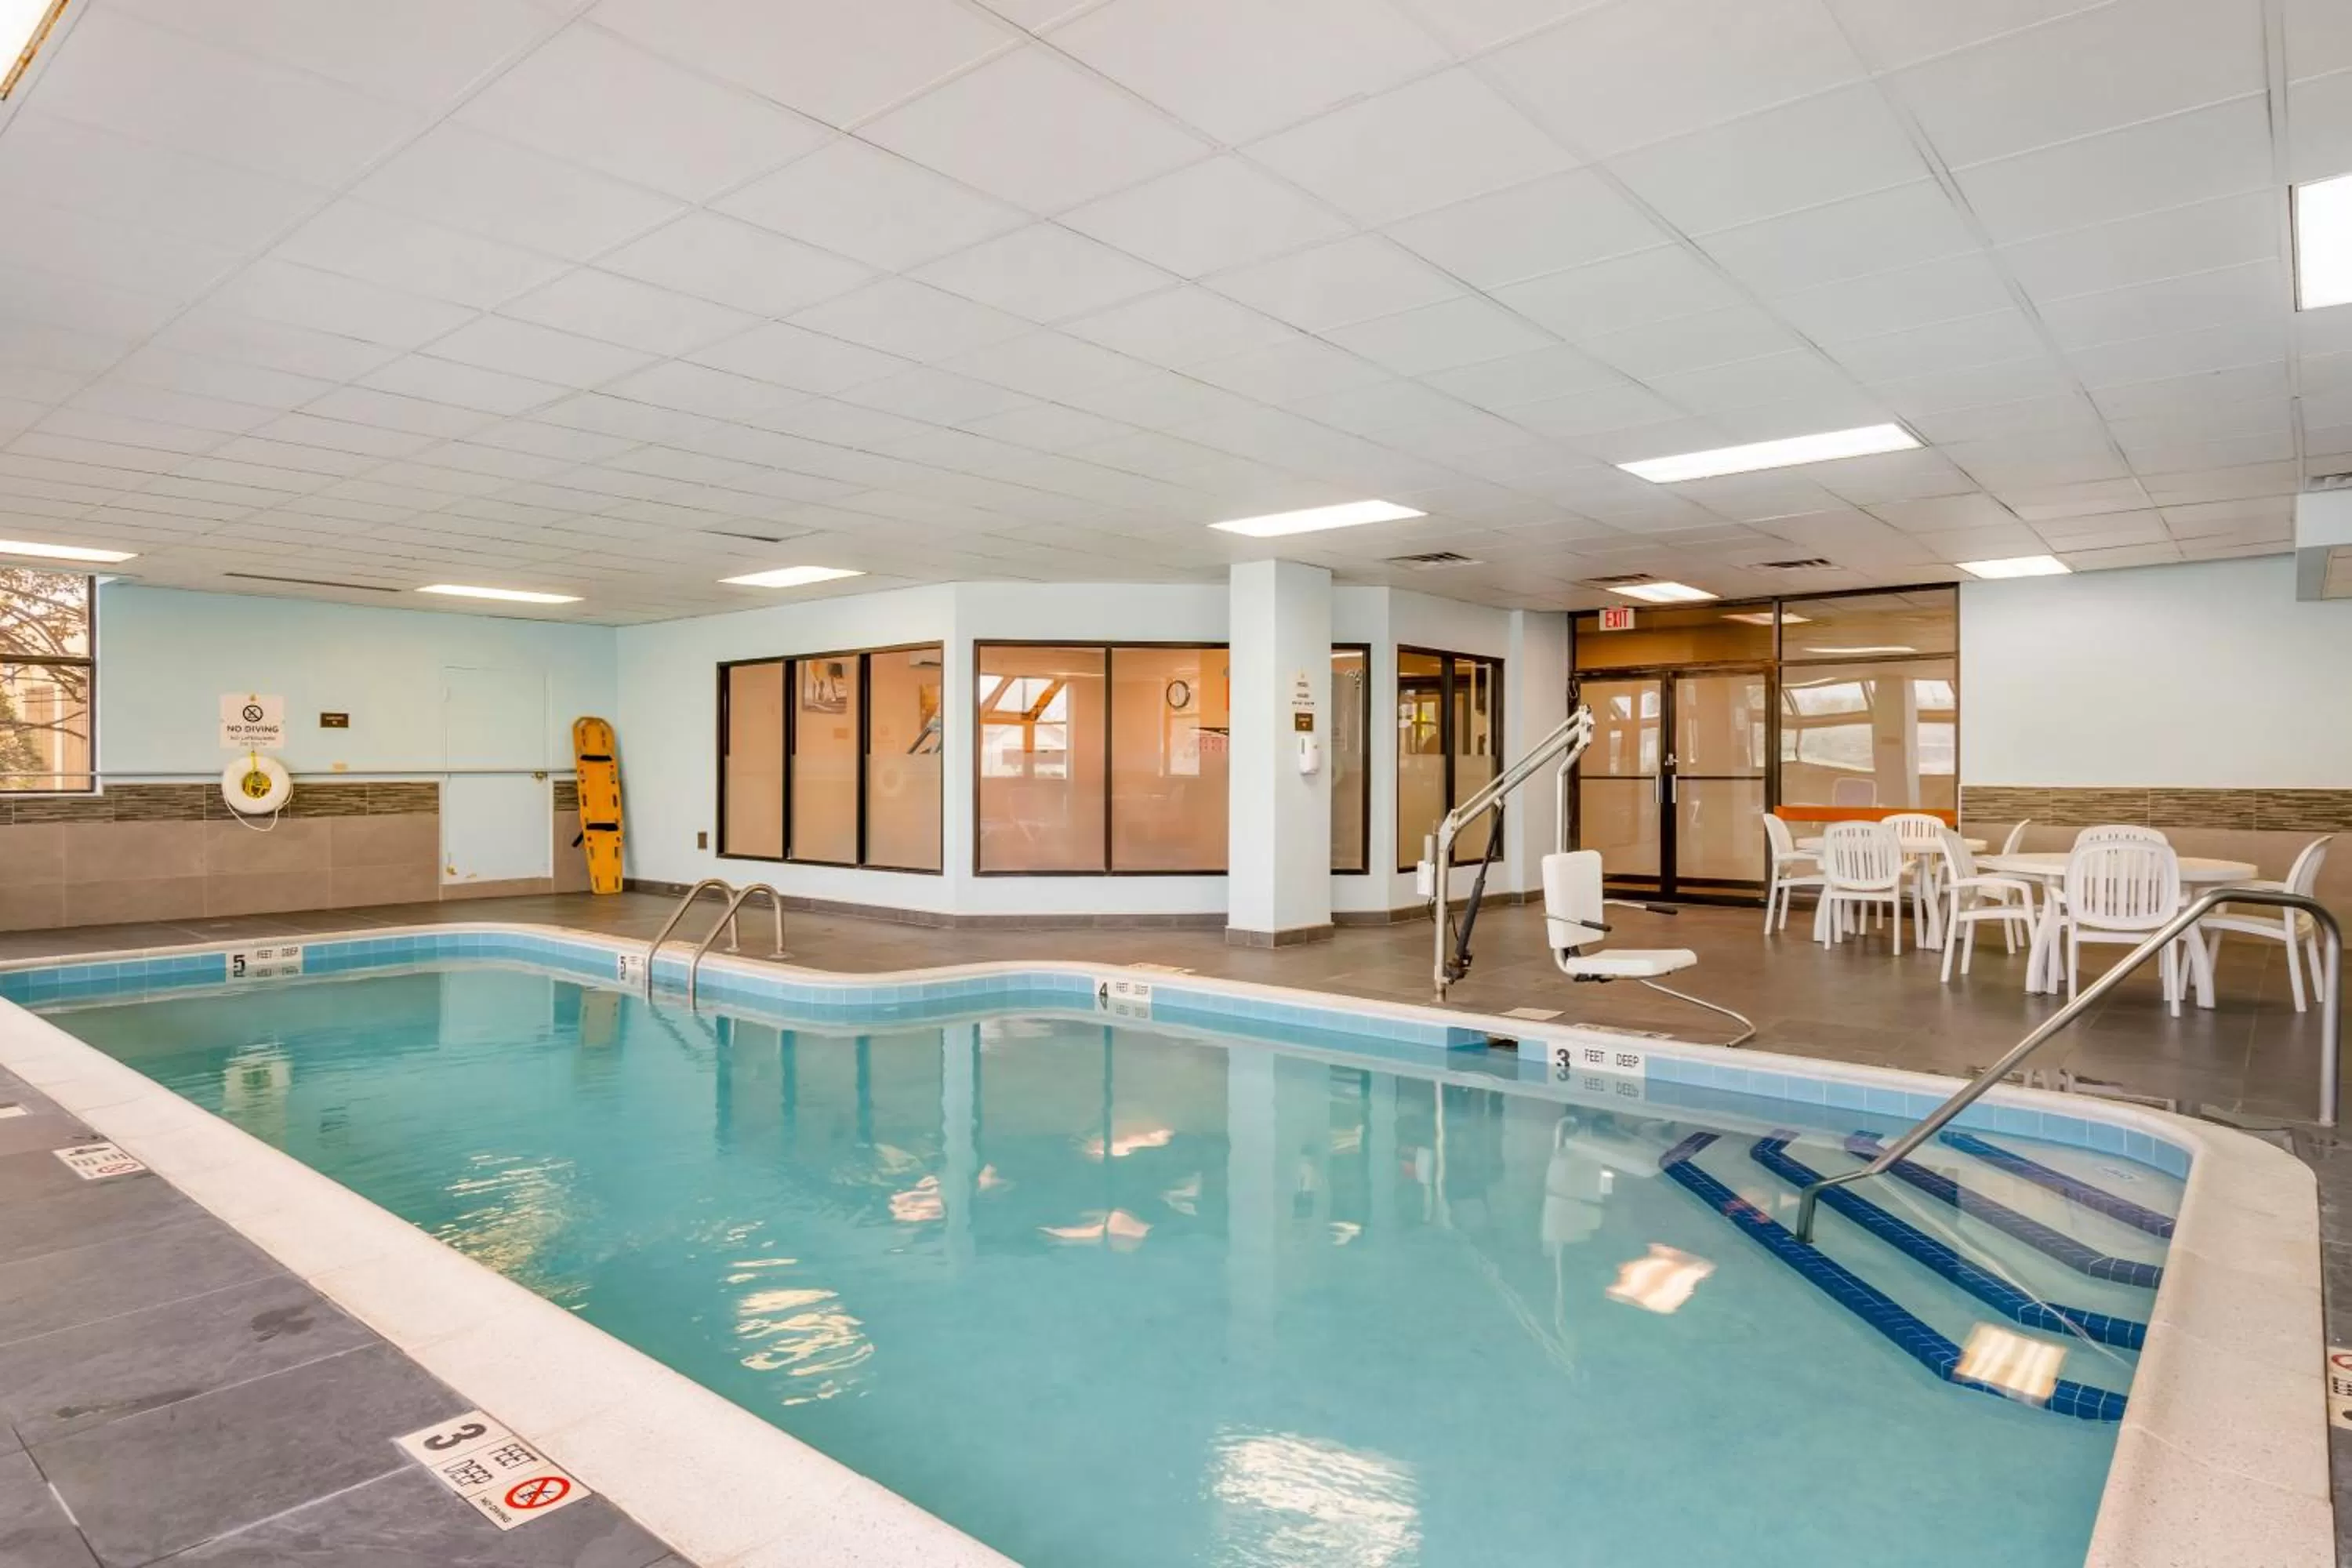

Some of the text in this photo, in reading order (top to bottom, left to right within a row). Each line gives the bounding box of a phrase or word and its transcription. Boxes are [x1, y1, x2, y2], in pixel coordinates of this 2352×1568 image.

[1605, 609, 1628, 628] EXIT
[226, 724, 279, 733] NO DIVING
[234, 954, 245, 969] 5
[256, 949, 273, 959] FEET
[1099, 982, 1108, 996] 4
[1555, 1048, 1640, 1068] 3 FEET DEEP
[423, 1423, 488, 1451] 3
[488, 1443, 539, 1470] FEET
[442, 1458, 494, 1487] DEEP
